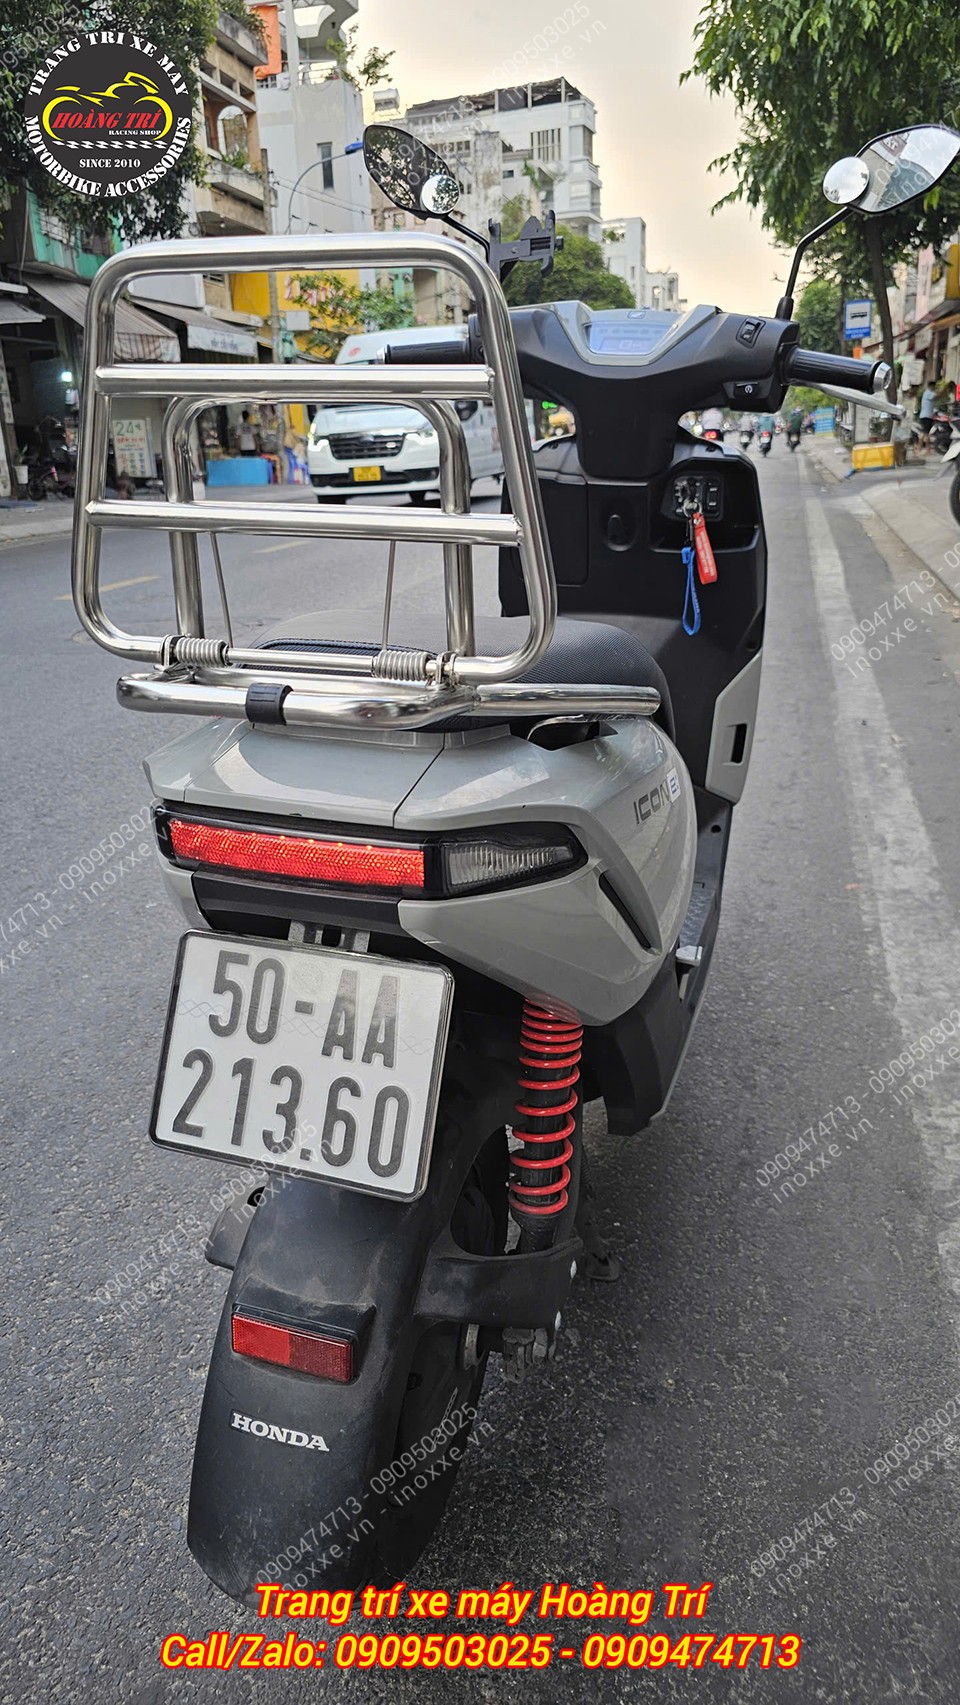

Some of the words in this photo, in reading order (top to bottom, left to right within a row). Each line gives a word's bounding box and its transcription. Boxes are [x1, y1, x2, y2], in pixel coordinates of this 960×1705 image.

[633, 780, 671, 825] ICON
[208, 950, 398, 1068] 50-AA
[172, 1048, 410, 1178] 213.60
[231, 1412, 330, 1452] HONDA
